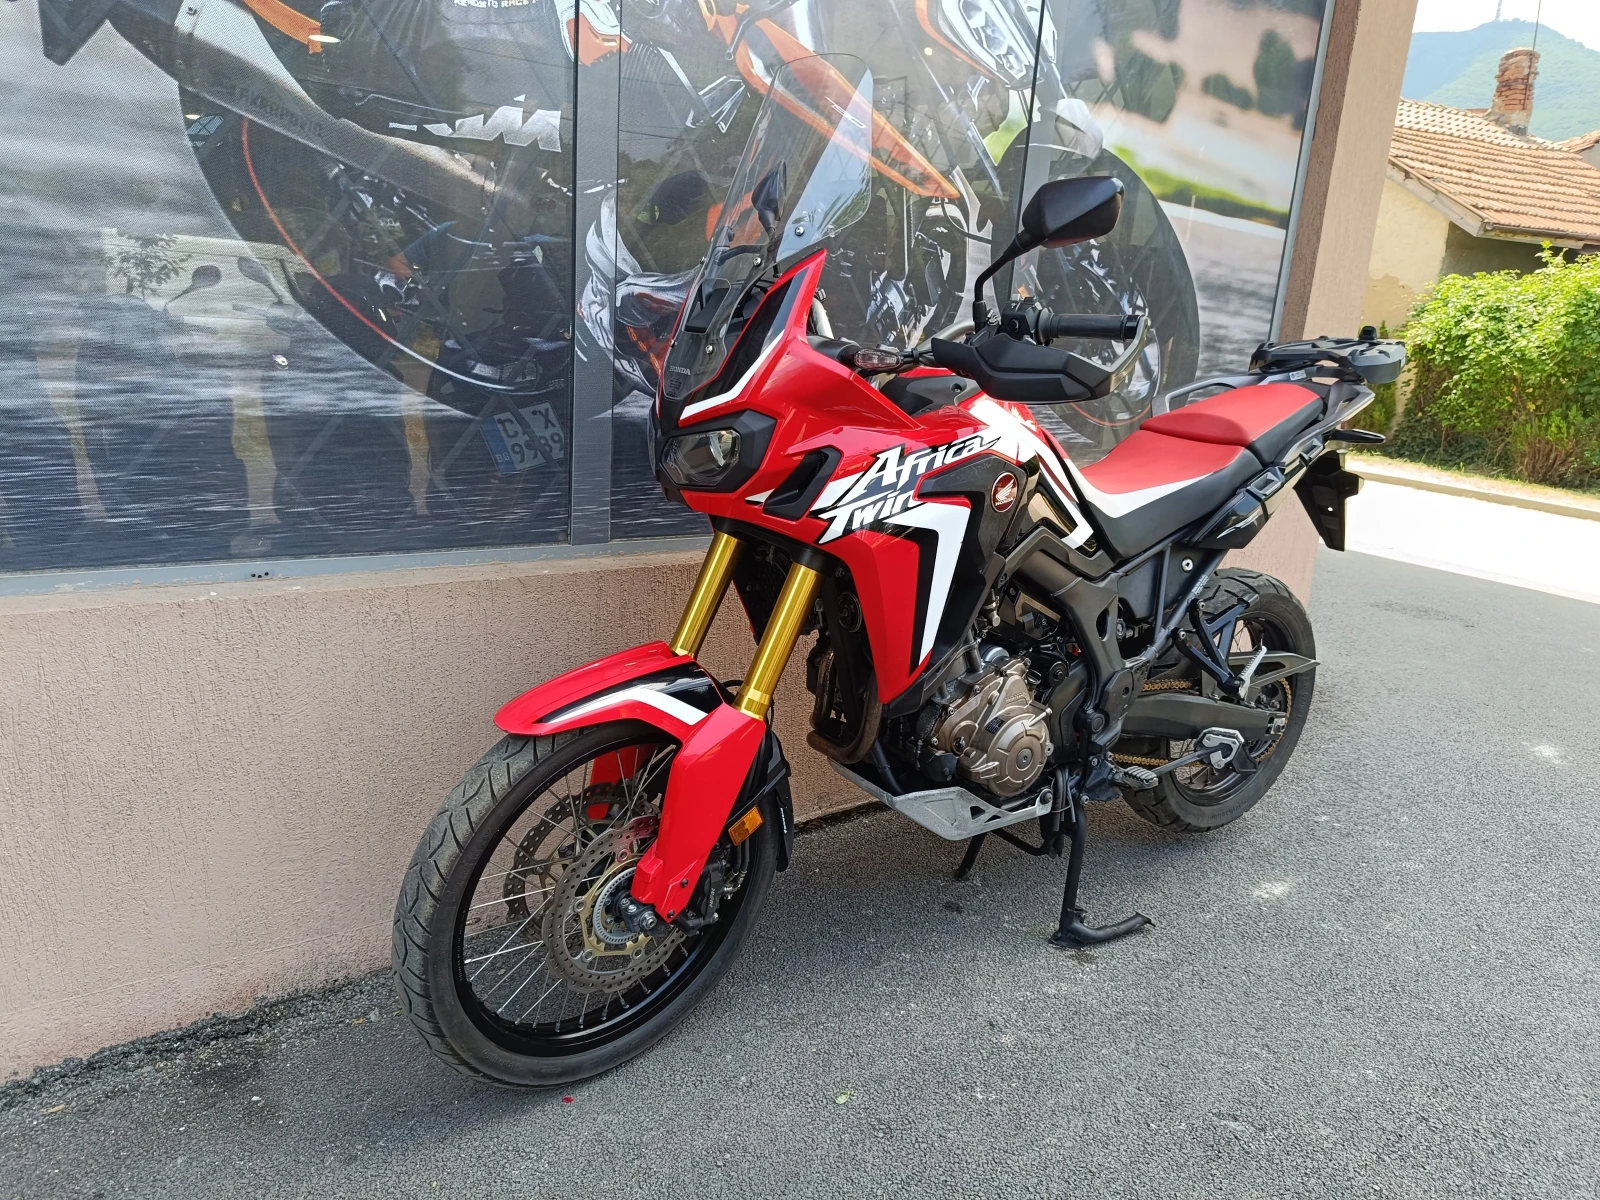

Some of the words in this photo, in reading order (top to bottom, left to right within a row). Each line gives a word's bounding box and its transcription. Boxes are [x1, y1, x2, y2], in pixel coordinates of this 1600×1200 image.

[670, 365, 691, 376] HONDA
[495, 452, 510, 463] BG
[834, 435, 1001, 508] Africa
[995, 497, 1015, 506] HONDA
[818, 490, 924, 544] Twin
